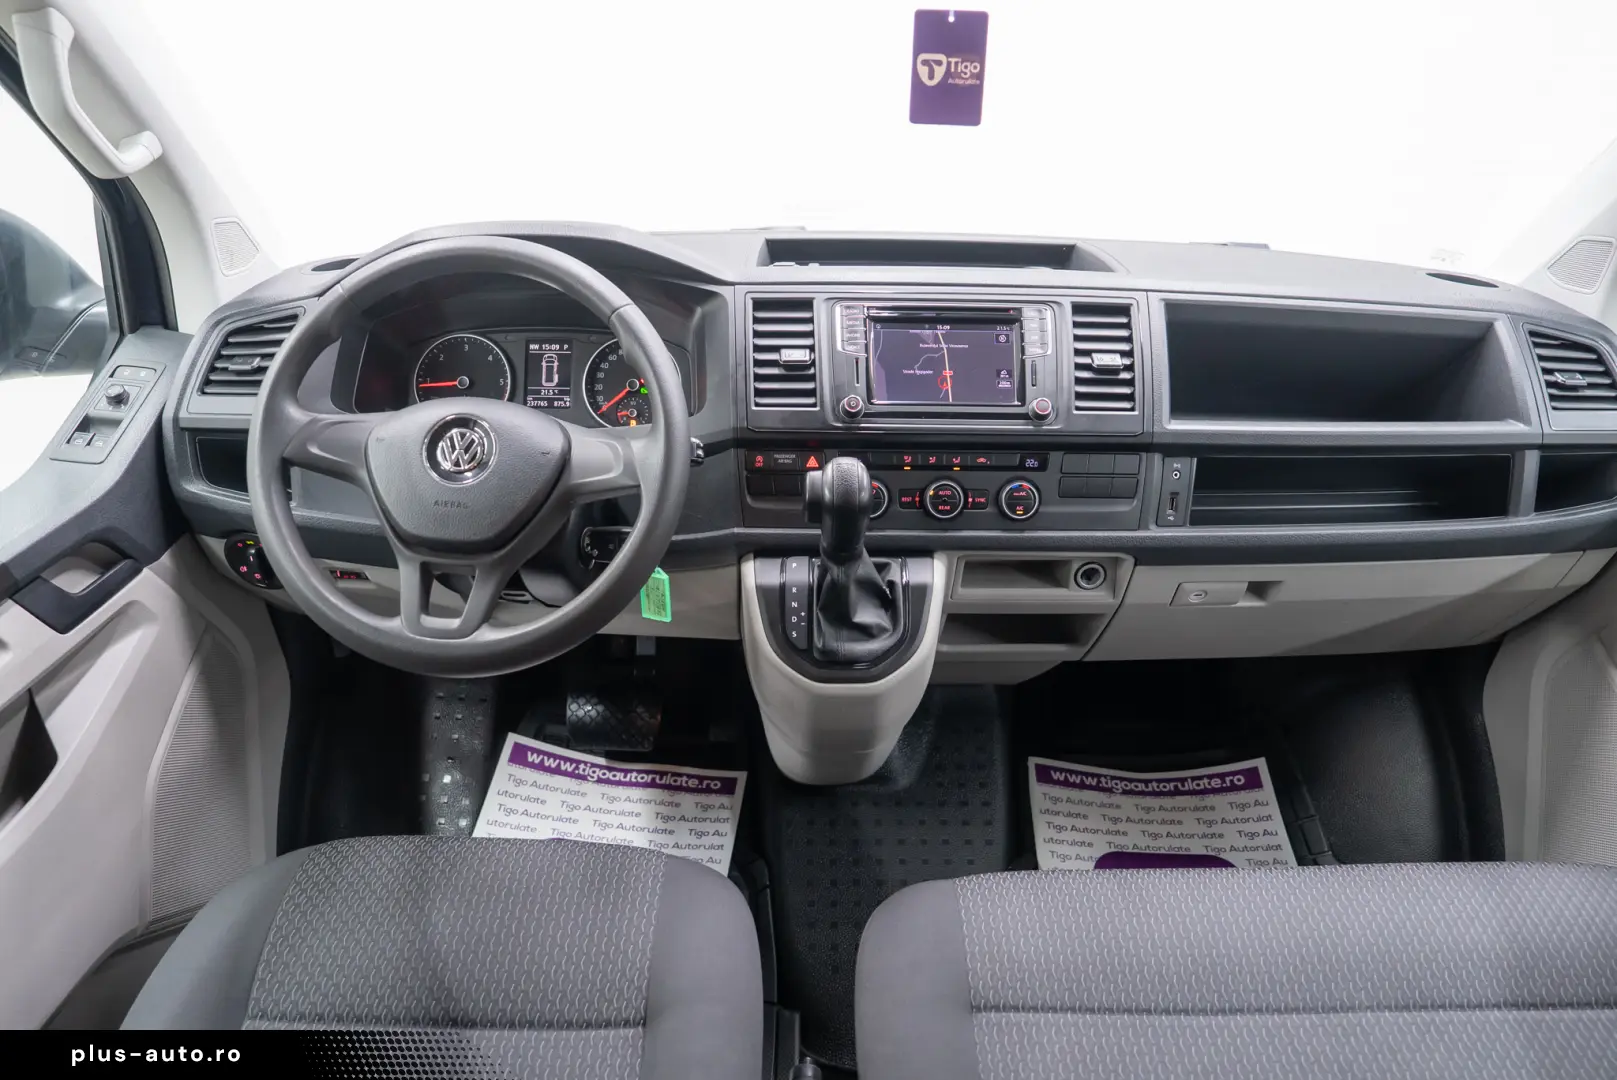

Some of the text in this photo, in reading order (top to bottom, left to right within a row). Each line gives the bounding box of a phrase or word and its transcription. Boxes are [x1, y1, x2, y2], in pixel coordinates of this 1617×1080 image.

[947, 57, 980, 78] Tigo
[463, 344, 469, 352] 3
[529, 343, 540, 351] NW
[541, 343, 560, 351] 15:09
[439, 353, 444, 361] 2
[596, 371, 605, 379] 30
[499, 378, 504, 386] 5
[594, 383, 603, 391] 20
[433, 501, 469, 509] AIRBAG
[792, 630, 797, 638] S
[526, 750, 722, 789] www.tigoautorulate.ro
[507, 773, 529, 788] Tigo
[529, 780, 588, 798] Autorulate
[1049, 769, 1245, 793] www.tigoautorulate.ro
[497, 788, 547, 806] utorulate
[600, 792, 682, 809] Tigo Autorulate
[1041, 792, 1064, 805] Tigo
[1065, 796, 1122, 809] Autorulate
[560, 800, 642, 818] Tigo Autorulate
[694, 801, 734, 812] Tigo Au
[1134, 803, 1216, 814] Tigo Autorulate
[1227, 799, 1269, 812] Tigo Au
[497, 803, 580, 825] Tigo Autorulate
[655, 811, 731, 824] Tigo Autorulat
[1039, 808, 1089, 820] utorulate
[1100, 813, 1184, 826] Tigo Autorulate
[486, 818, 538, 833] utorulate
[1194, 813, 1274, 828] Tigo Autorulat
[592, 819, 676, 836] Tigo Autorulate
[1045, 821, 1129, 837] Tigo Autorulate
[550, 827, 634, 845] Tigo Autorulate
[687, 828, 728, 840] Tigo Au
[1140, 829, 1224, 841] Tigo Autorulate
[1236, 828, 1279, 840] Tigo Au
[647, 839, 725, 851] Tigo Autorulat
[1043, 837, 1094, 849] utorulate
[1106, 841, 1191, 853] Tigo Autorulate
[1202, 843, 1283, 855] Tigo Autorulat
[1048, 850, 1072, 863] Tigo
